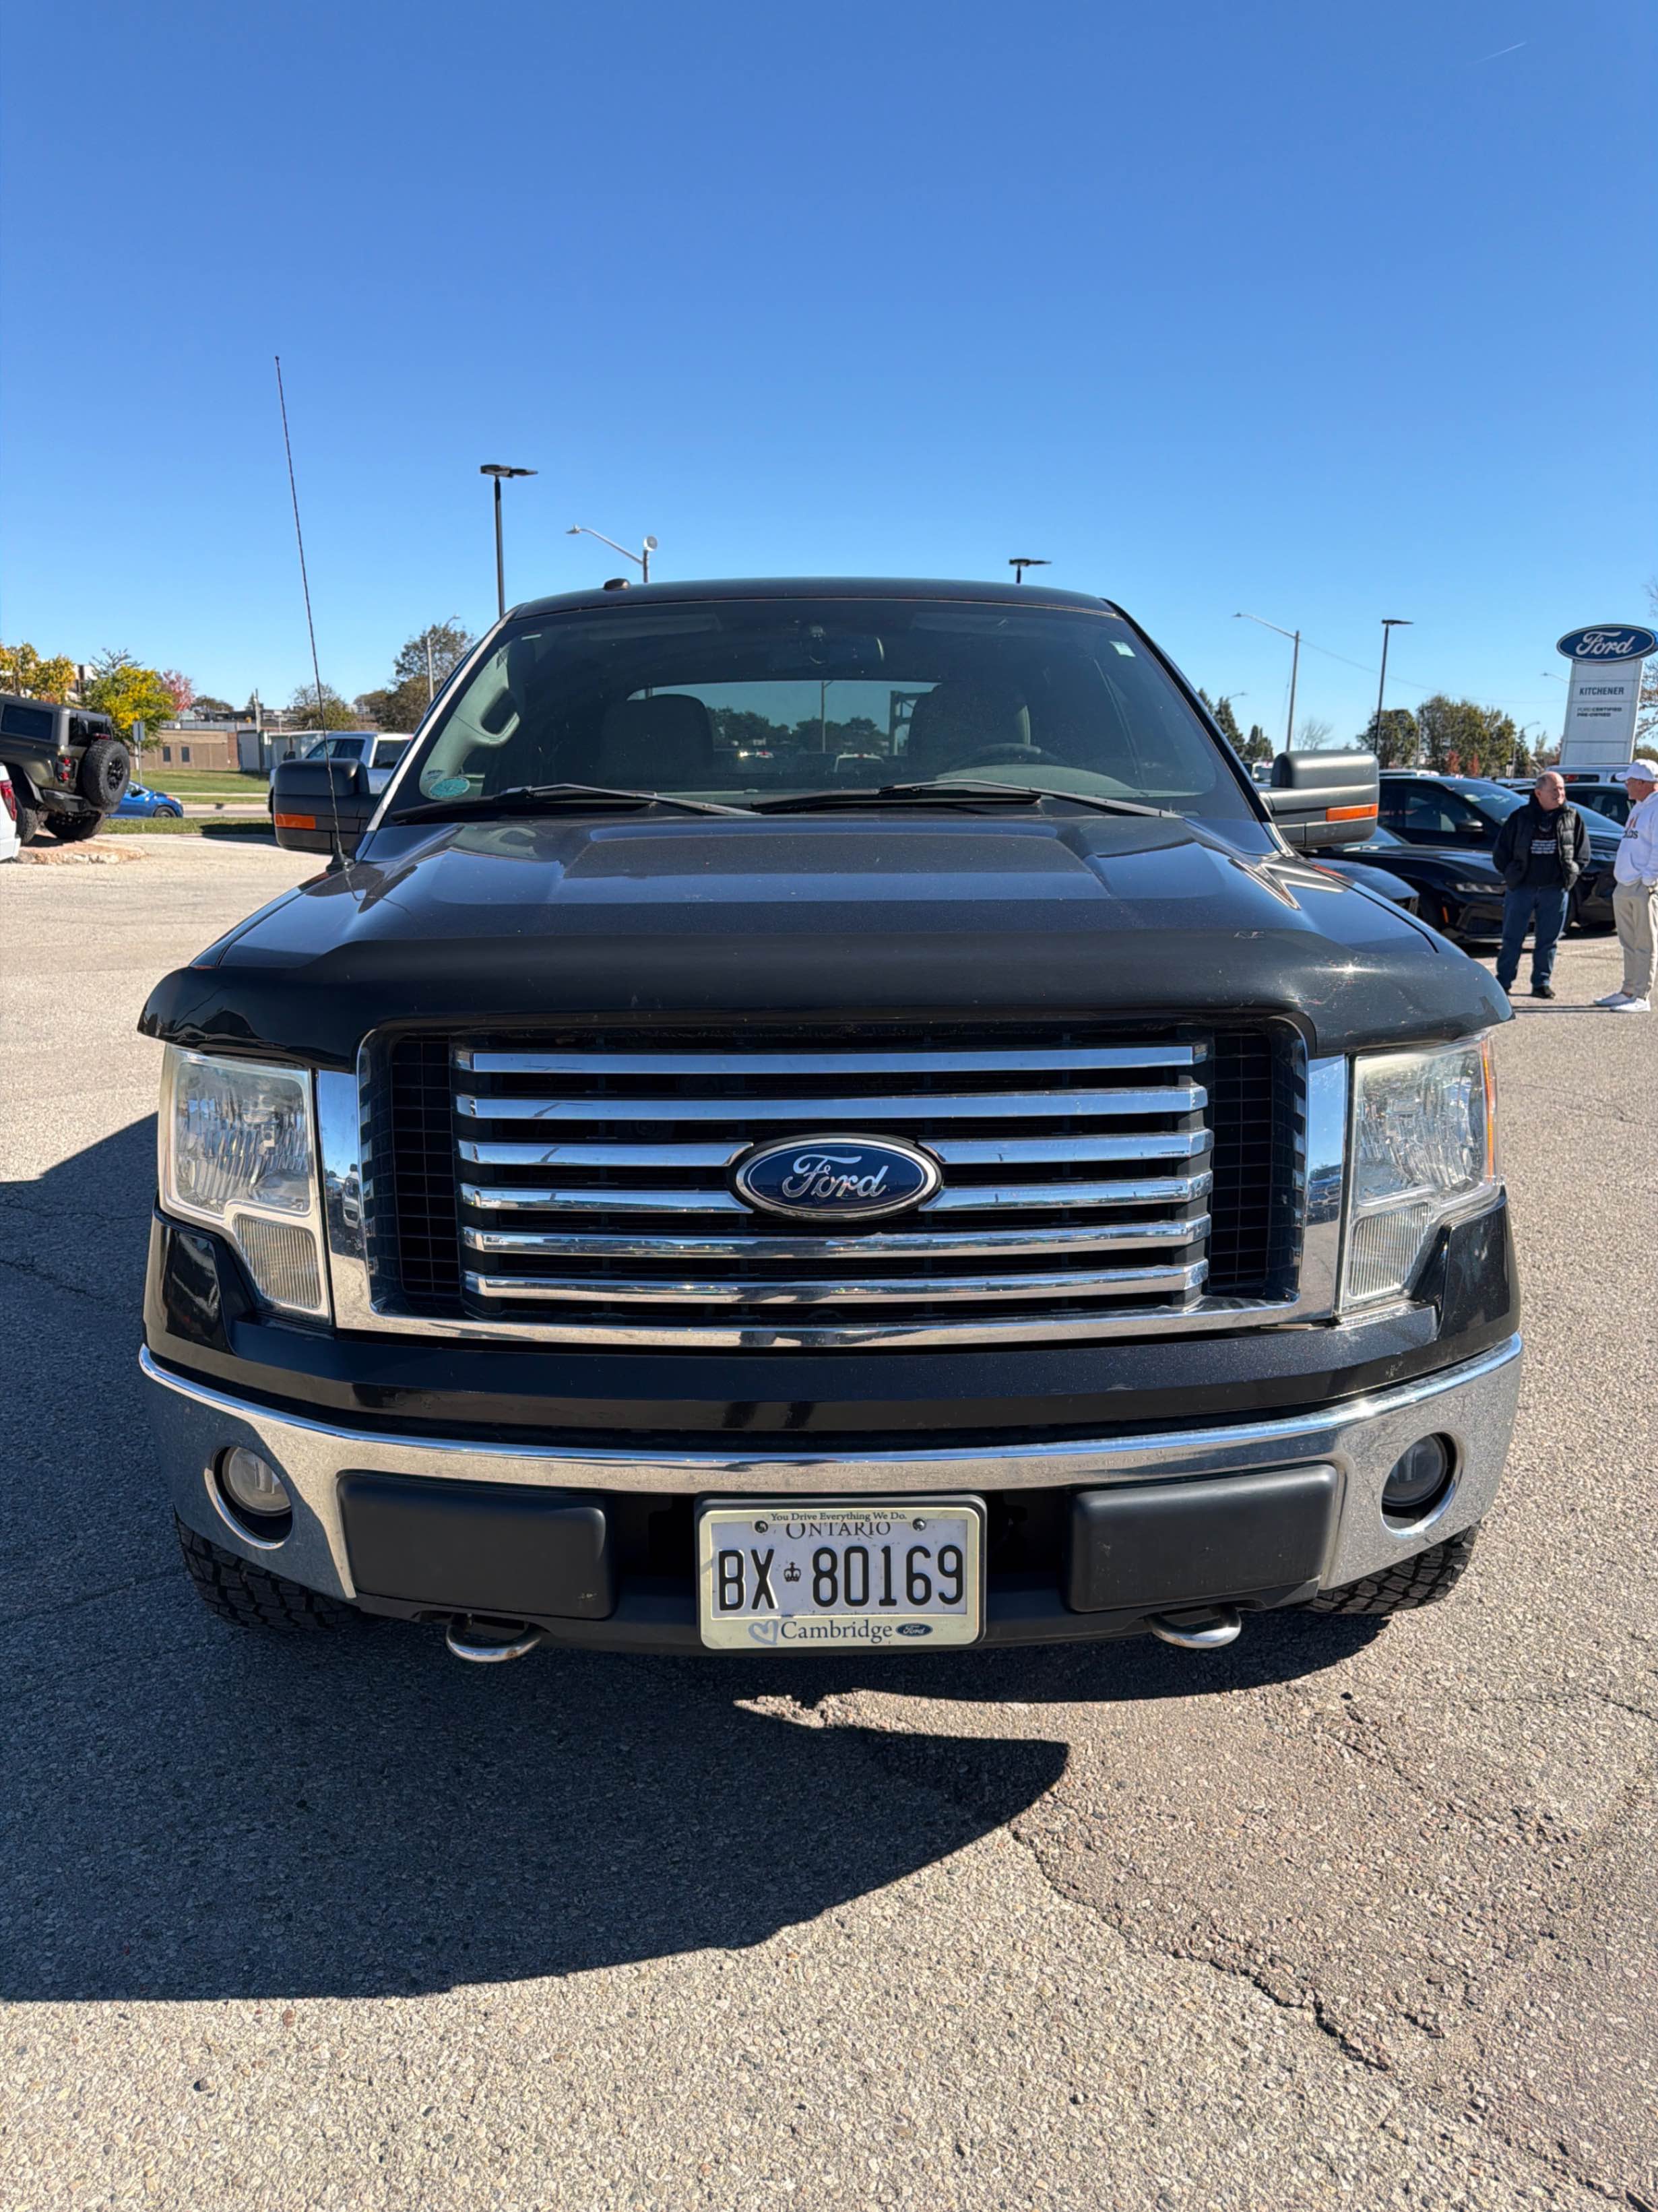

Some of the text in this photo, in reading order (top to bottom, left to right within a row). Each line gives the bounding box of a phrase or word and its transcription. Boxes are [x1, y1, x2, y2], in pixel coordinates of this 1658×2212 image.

[1575, 631, 1636, 656] Ford
[1579, 687, 1624, 696] KITCHENER
[782, 1154, 889, 1198] Ford
[770, 1511, 907, 1522] You Drive Everything We Do.
[786, 1521, 891, 1540] ONTARIO
[718, 1544, 964, 1611] BX 80169
[781, 1619, 925, 1644] Cambridge Ford
